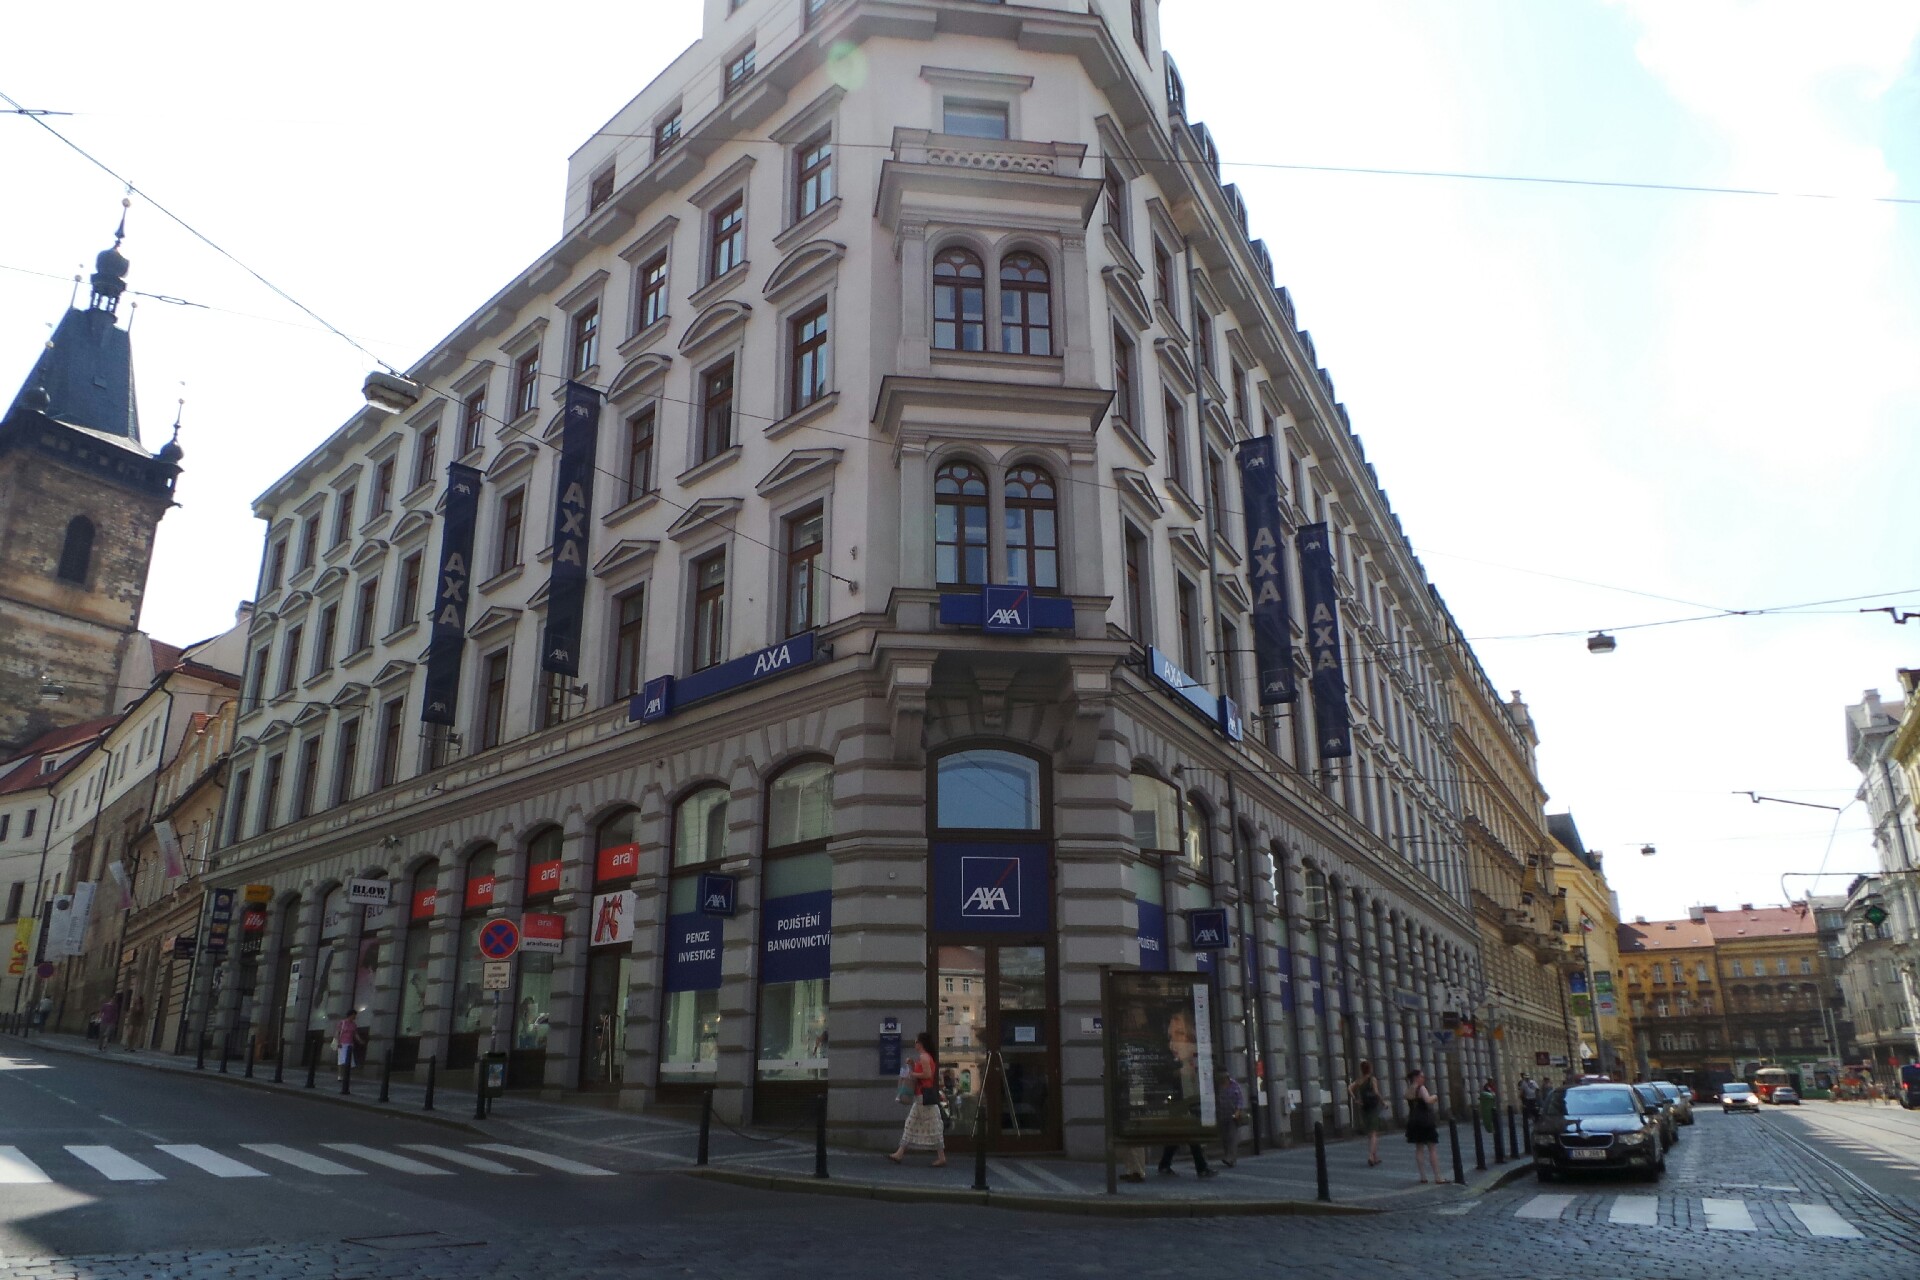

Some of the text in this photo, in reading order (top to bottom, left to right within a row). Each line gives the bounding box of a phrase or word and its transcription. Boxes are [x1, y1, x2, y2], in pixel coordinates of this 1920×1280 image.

[569, 404, 590, 418] AXA
[1246, 457, 1265, 467] AXA
[452, 483, 471, 495] AXA
[557, 481, 586, 567] AXA
[1305, 541, 1321, 550] AXA
[1253, 527, 1282, 605] AXA
[438, 552, 466, 629] AXA
[987, 608, 1021, 625] AXA
[1312, 602, 1338, 671] AXA
[549, 648, 570, 662] AXA
[753, 645, 791, 675] AXA
[1164, 662, 1183, 691] AXA
[1265, 681, 1287, 693] AXA
[428, 701, 446, 713] AXA
[644, 697, 662, 718] AXA
[1324, 738, 1342, 749] AXA
[612, 852, 631, 866] ara
[541, 869, 557, 881] ara
[352, 885, 387, 896] BLOW
[477, 882, 491, 894] ara
[422, 894, 435, 906] ara
[704, 894, 728, 908] AXA
[963, 887, 1010, 910] AXA
[245, 914, 263, 927] illy
[537, 918, 552, 927] ara
[777, 911, 821, 931] POJIŠTĚNÍ
[685, 931, 710, 944] PENZE
[767, 931, 831, 953] BANKOVNICTVÍ
[1195, 929, 1219, 943] AXA
[678, 948, 716, 963] INVESTICE
